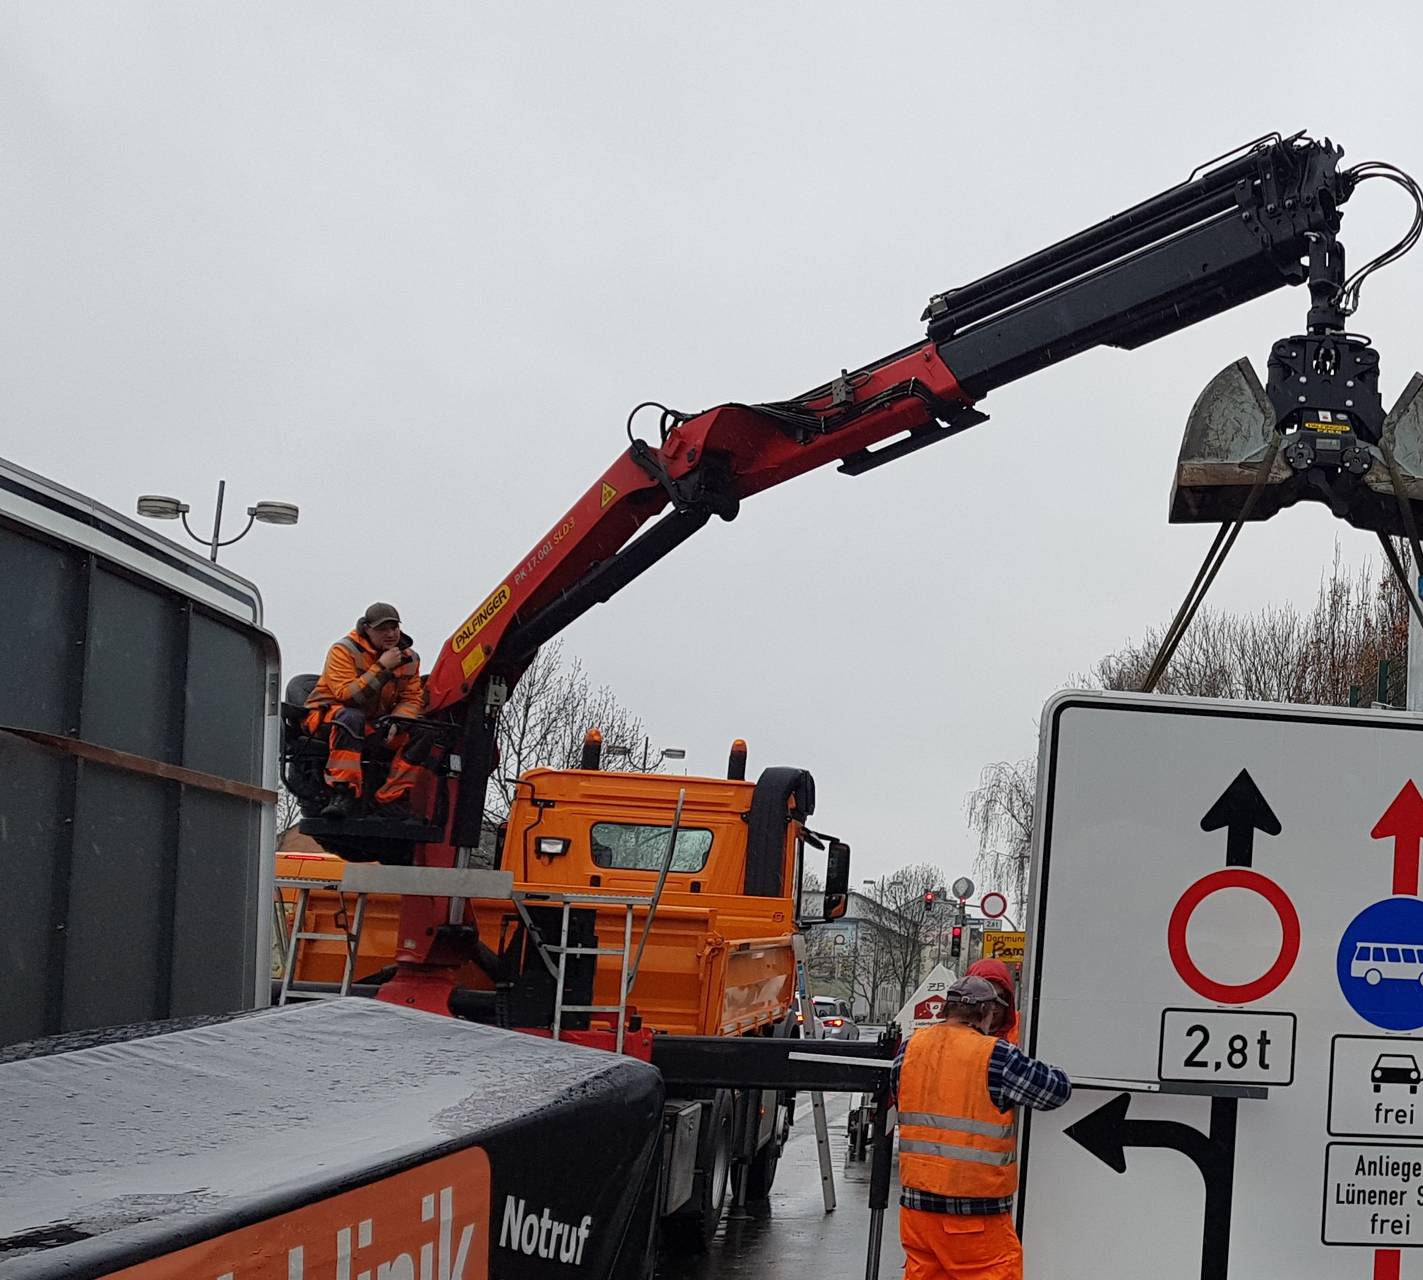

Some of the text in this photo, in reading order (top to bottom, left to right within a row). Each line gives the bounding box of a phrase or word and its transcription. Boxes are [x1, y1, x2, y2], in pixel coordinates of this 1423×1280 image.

[513, 567, 527, 585] PK
[455, 589, 508, 649] PALFINGER
[986, 934, 1025, 942] Dortmun
[1374, 1102, 1415, 1125] frei
[1335, 1182, 1408, 1206] Lünener
[499, 1194, 592, 1266] Notruf
[1370, 1212, 1411, 1236] frei
